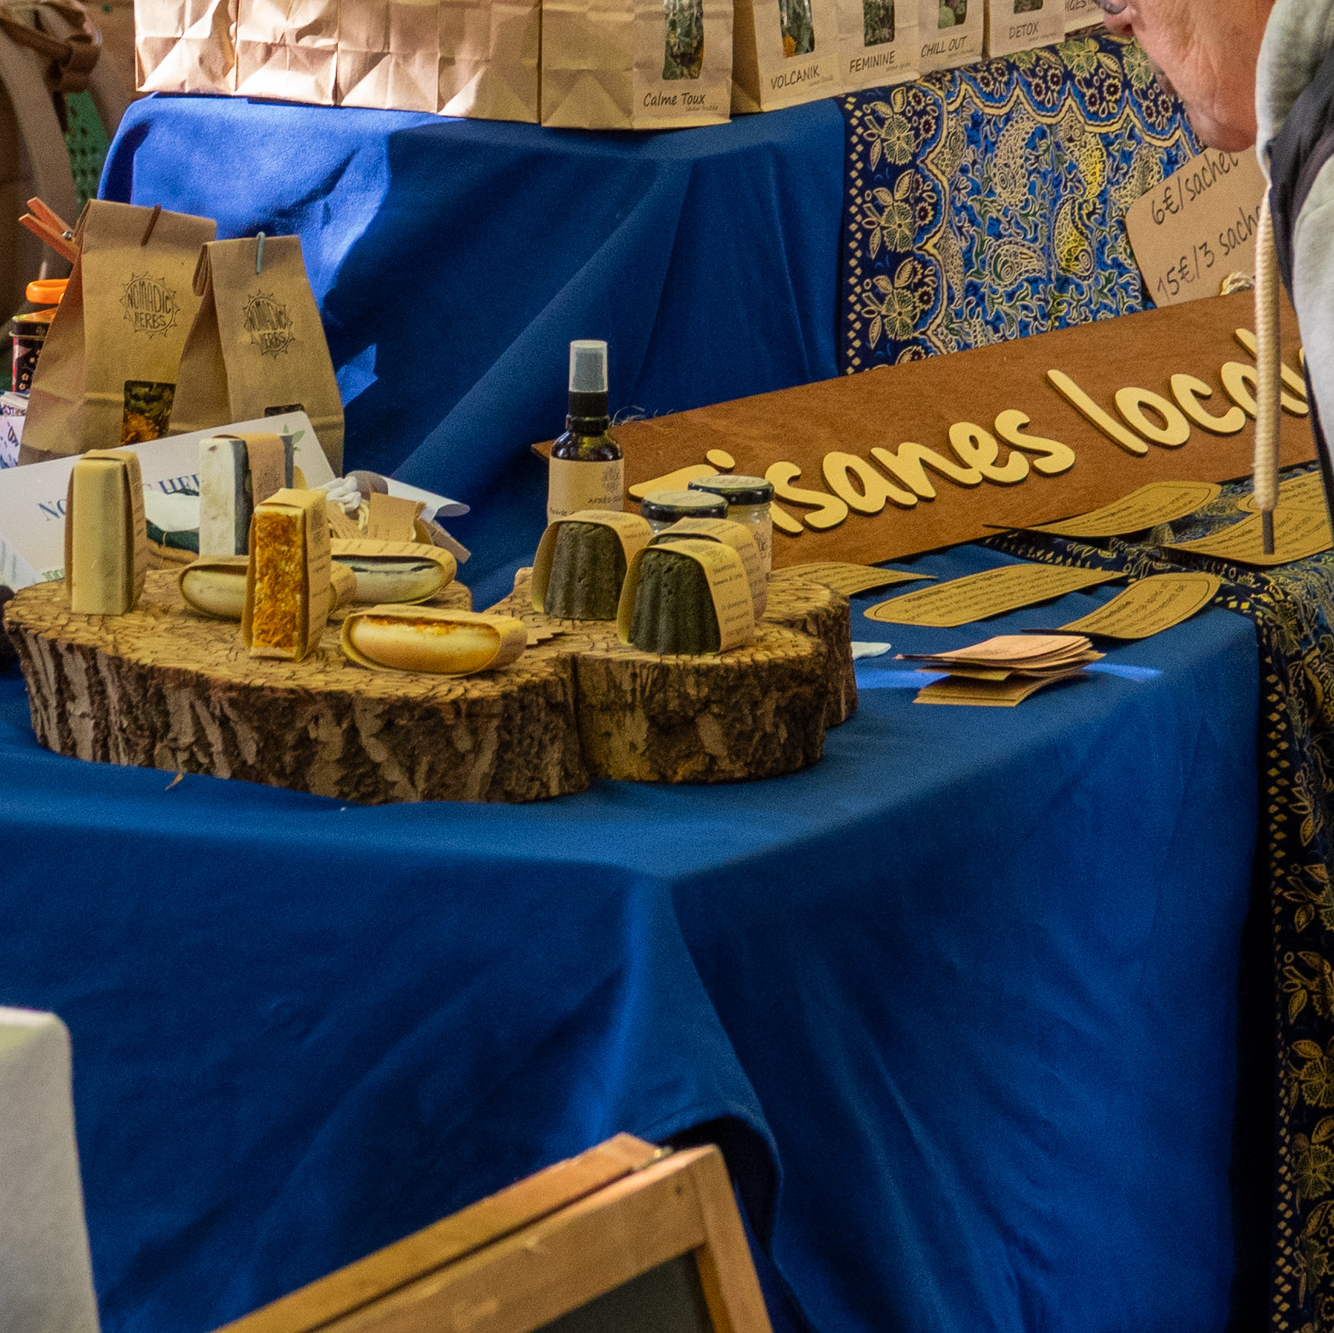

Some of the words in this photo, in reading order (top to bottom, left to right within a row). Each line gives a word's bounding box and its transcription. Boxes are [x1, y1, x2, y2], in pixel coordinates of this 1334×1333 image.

[1009, 21, 1039, 39] DETOX
[920, 42, 945, 58] CHILL
[948, 36, 967, 51] OUT
[849, 50, 896, 73] FEMININE
[770, 65, 820, 90] VOLCANIK
[643, 91, 678, 108] Calme
[681, 90, 706, 106] Toux
[1157, 241, 1215, 301] 15€/3
[127, 279, 172, 315] NOMADIC
[1046, 328, 1309, 455] local
